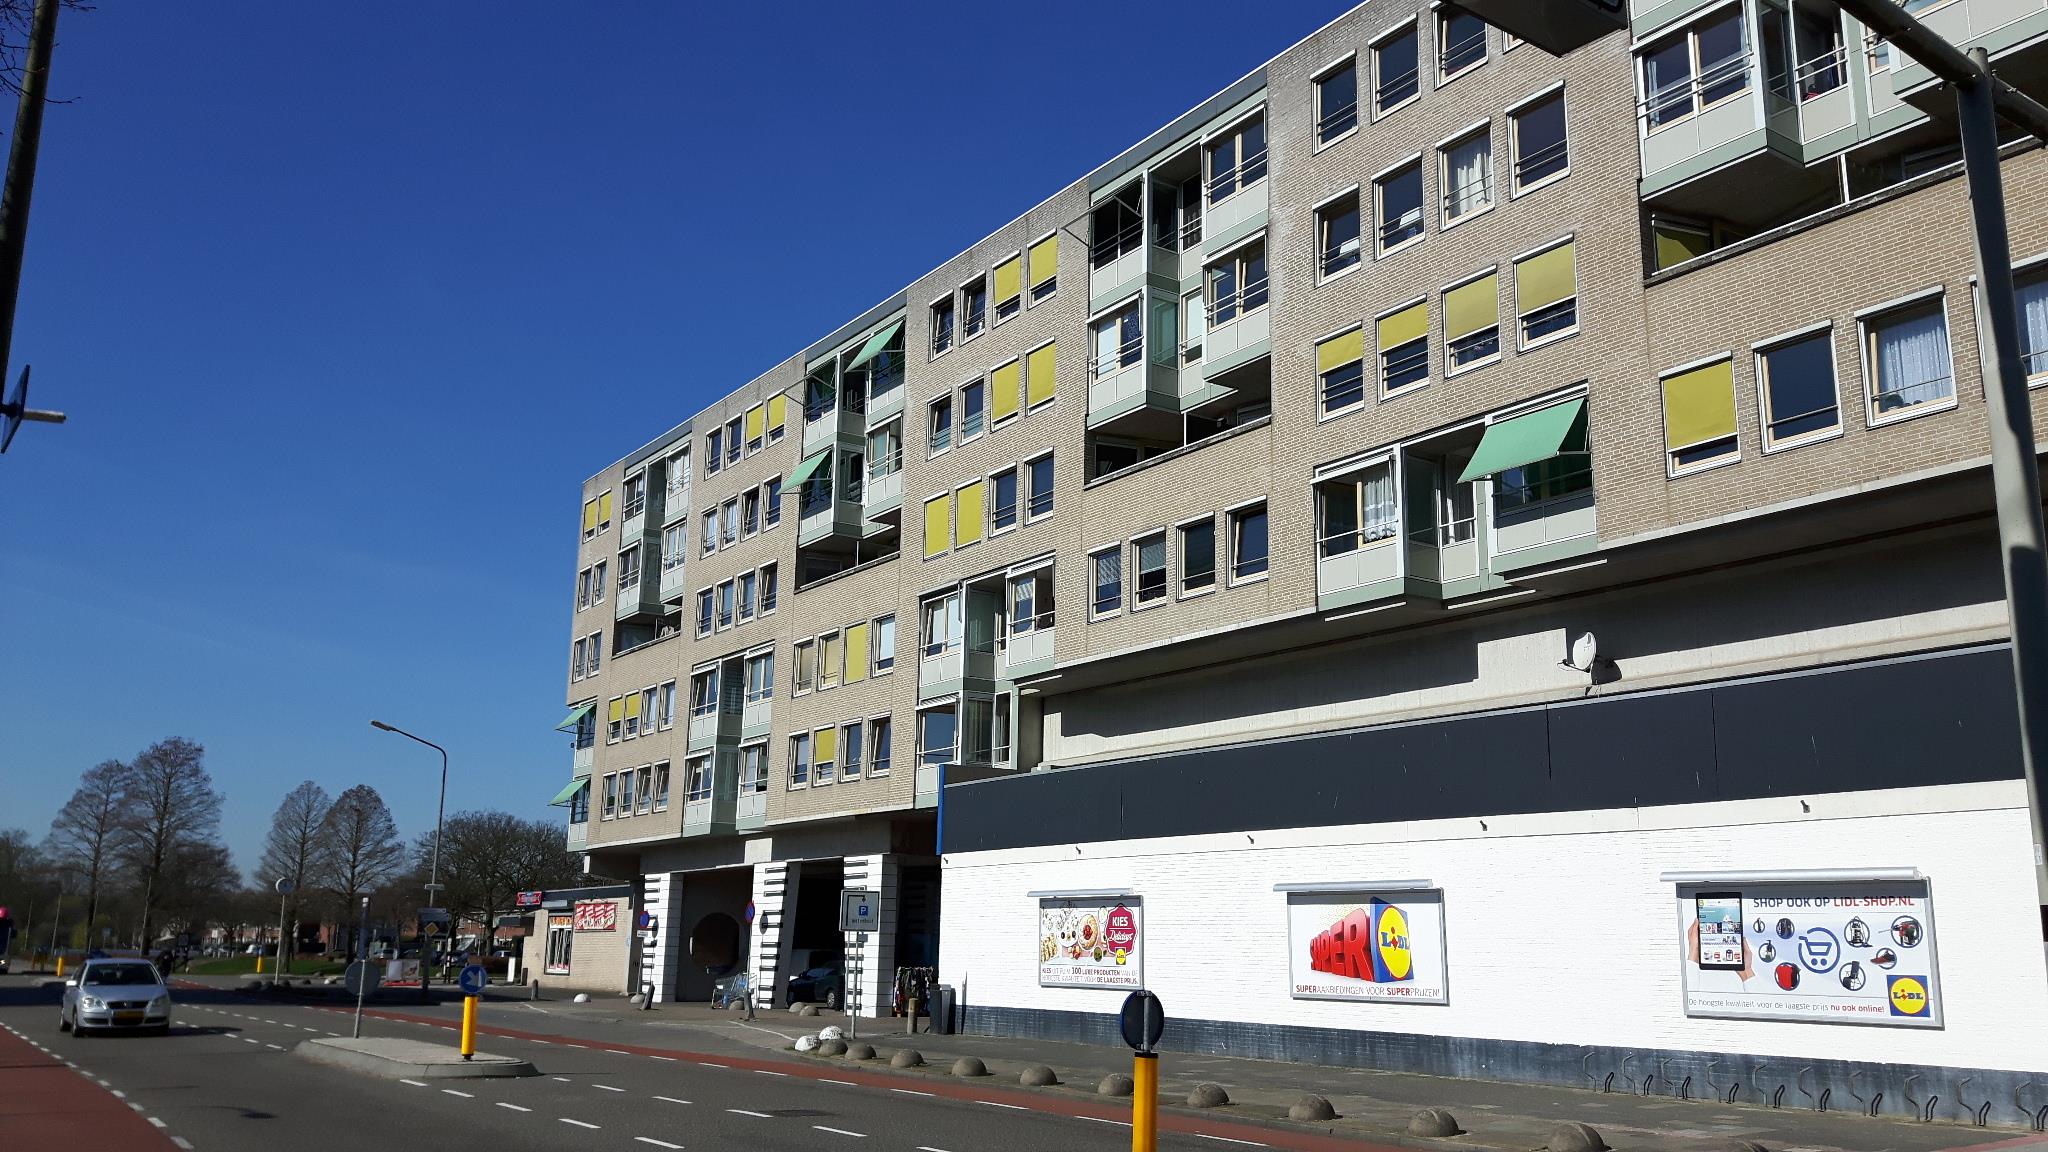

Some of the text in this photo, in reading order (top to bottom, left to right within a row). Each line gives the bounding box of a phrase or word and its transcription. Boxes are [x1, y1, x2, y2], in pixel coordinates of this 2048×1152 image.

[1753, 895, 1915, 908] SHOP OOK OP LIDL-SHOP.NL
[1112, 916, 1128, 927] KIES
[1310, 907, 1374, 982] SUPER
[1093, 968, 1120, 976] PRODUCTEN
[1103, 976, 1124, 984] LAAGSTE
[1296, 984, 1440, 998] SUPERAANBIEDINGEN VOOR SUPERPRIJZEN!
[1688, 998, 1697, 1006] De
[1698, 998, 1724, 1008] hoogste
[1725, 999, 1754, 1008] kwaliteit
[1785, 1002, 1810, 1011] laagste
[1812, 1003, 1829, 1012] prijs
[1841, 1004, 1857, 1012] ook
[1858, 1004, 1885, 1013] online!
